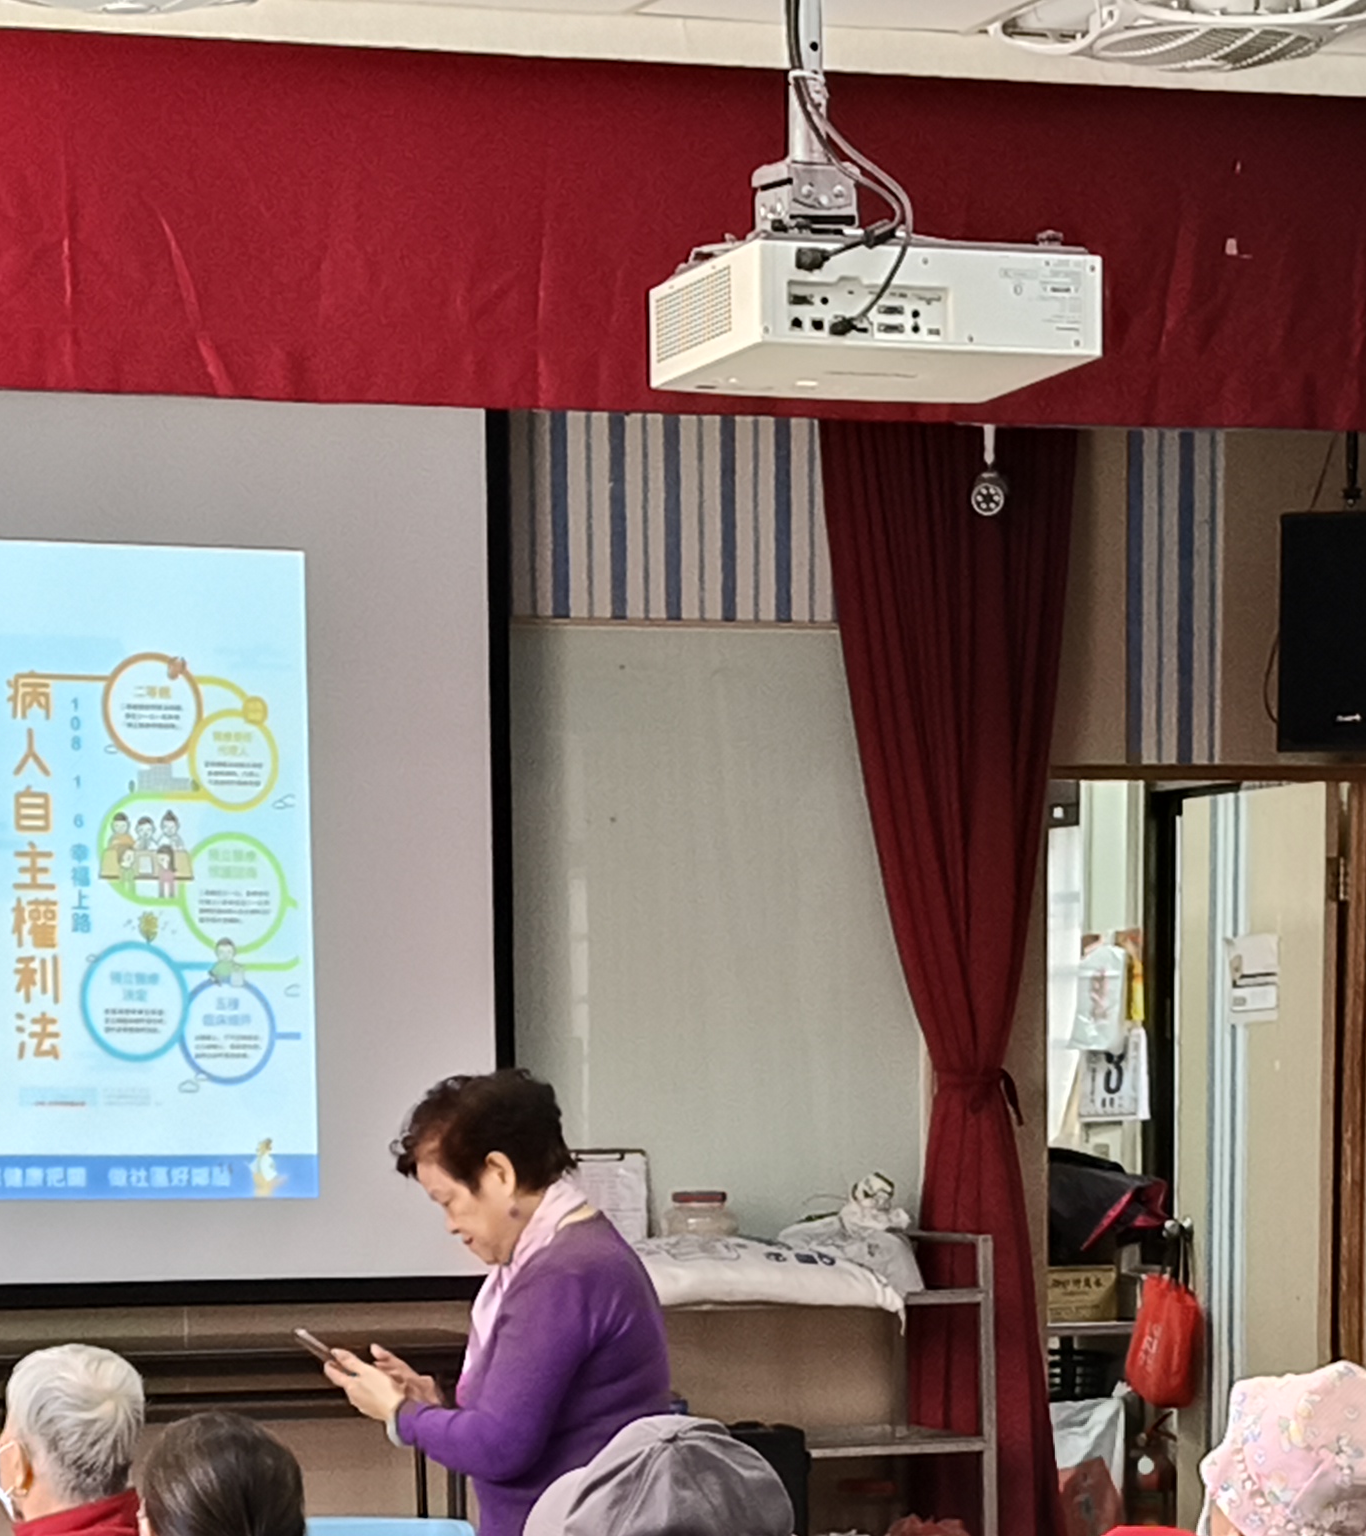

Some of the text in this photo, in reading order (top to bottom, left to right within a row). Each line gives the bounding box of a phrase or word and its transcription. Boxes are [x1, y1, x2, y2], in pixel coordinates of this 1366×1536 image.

[5, 670, 63, 1061] 病人自主權利法
